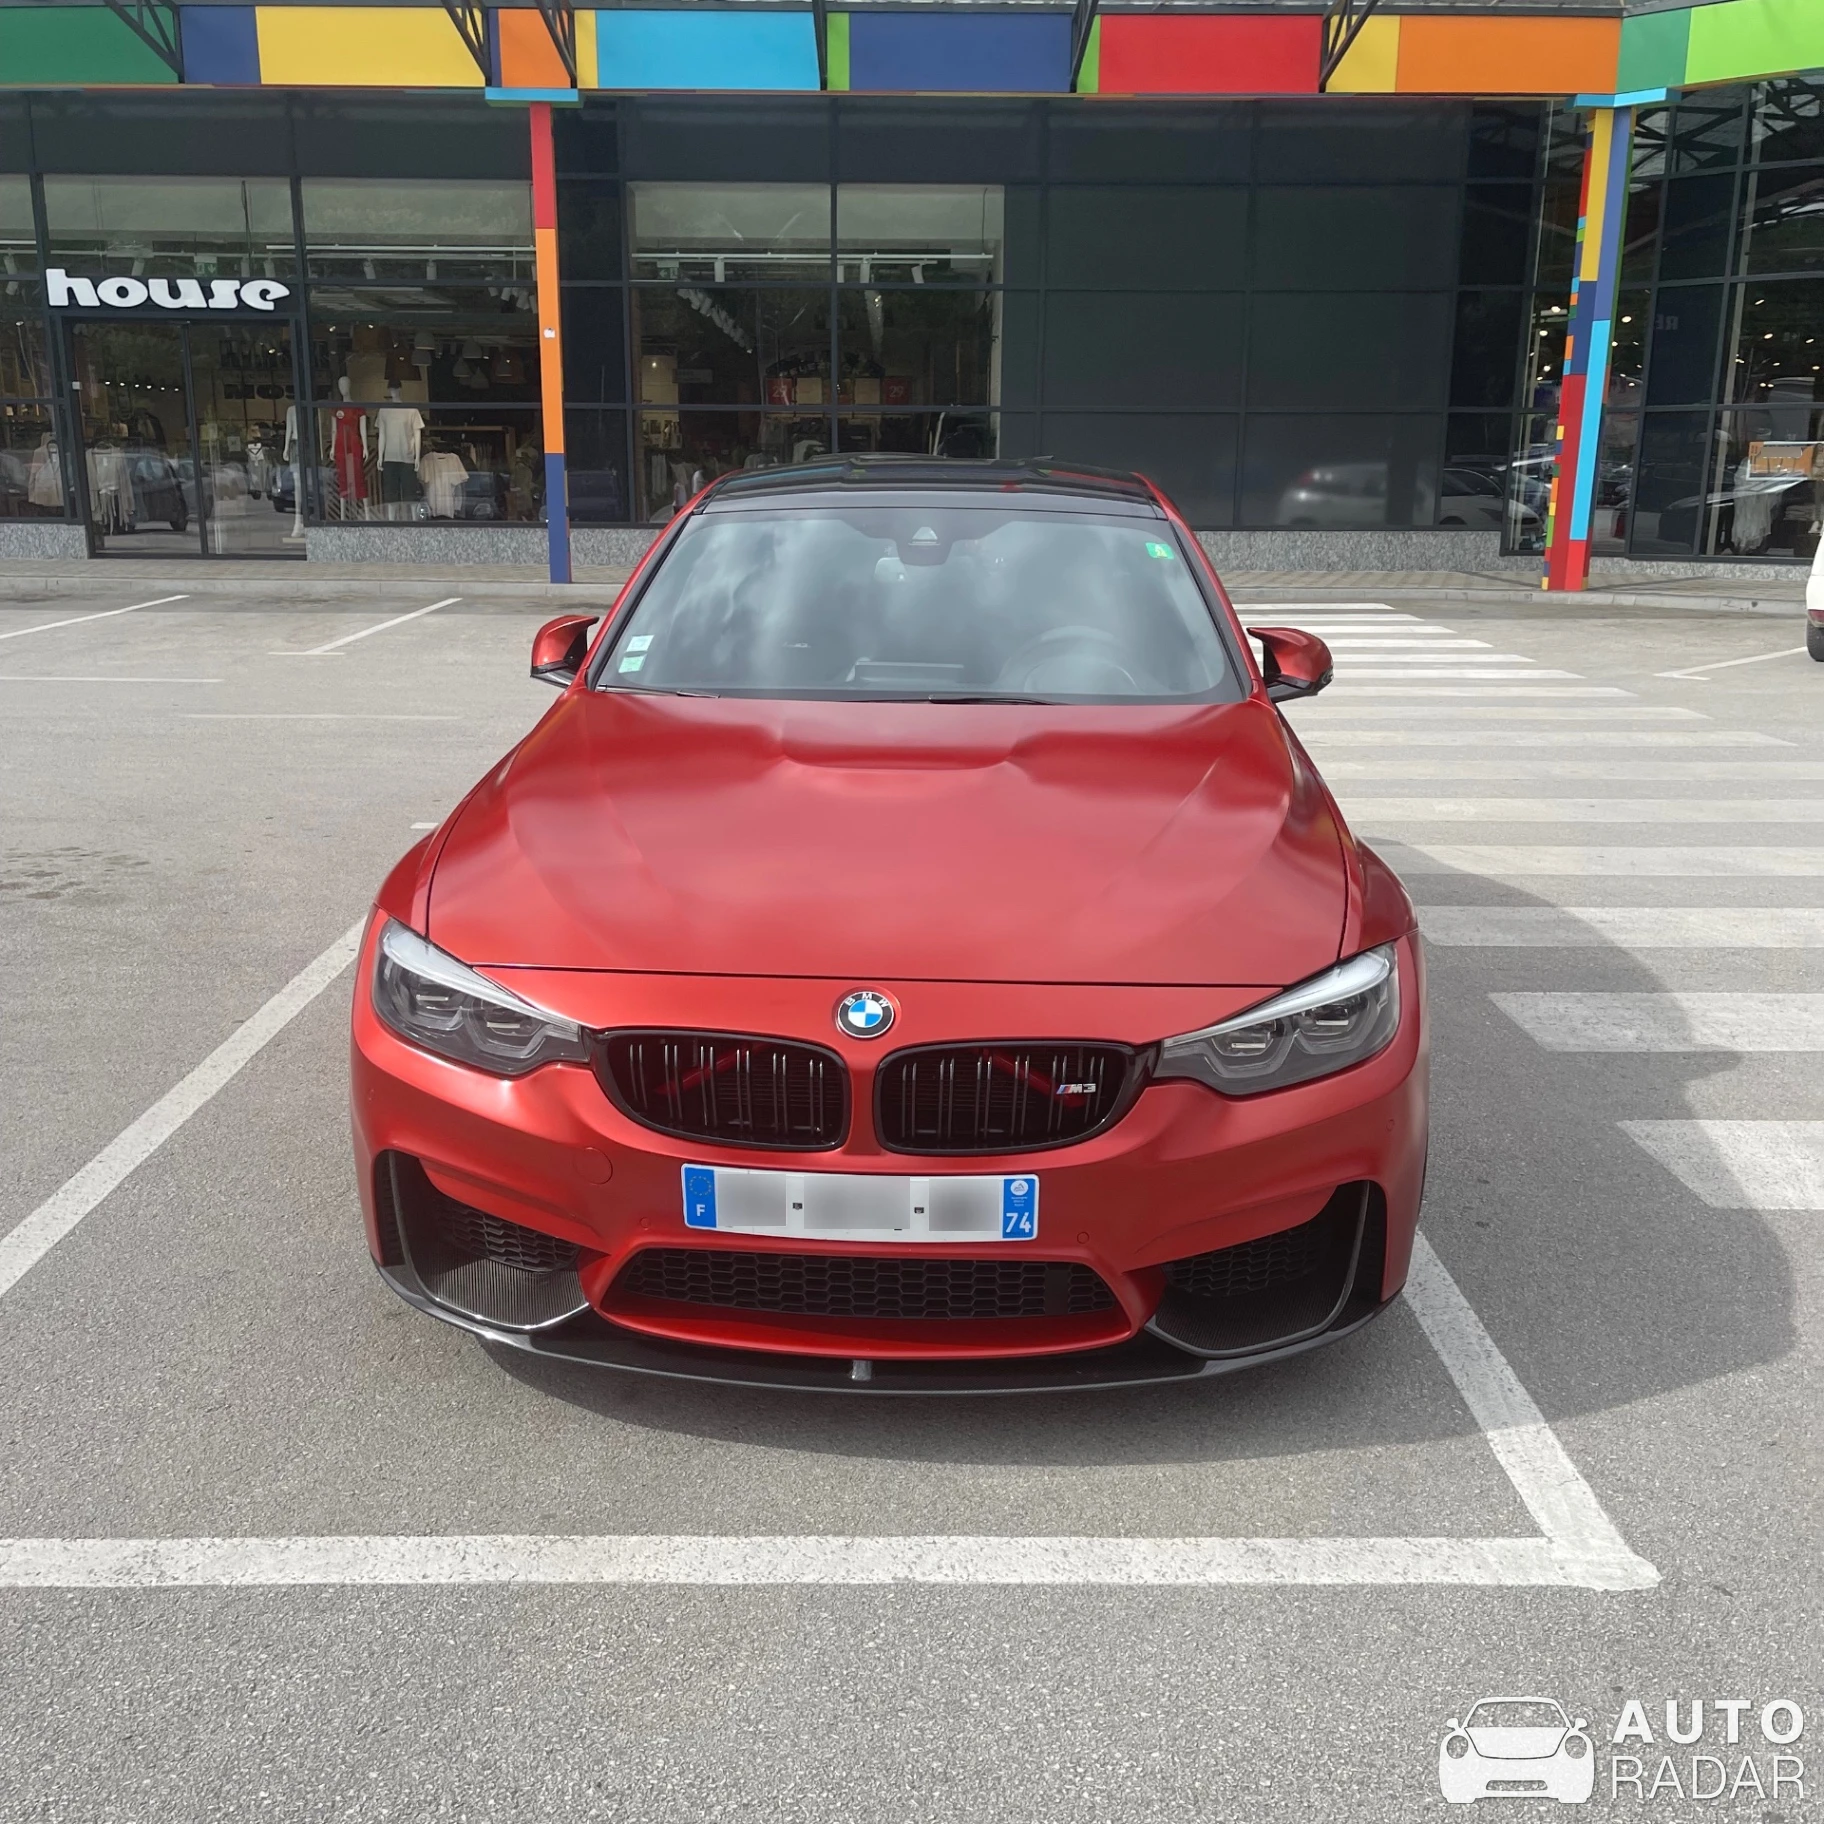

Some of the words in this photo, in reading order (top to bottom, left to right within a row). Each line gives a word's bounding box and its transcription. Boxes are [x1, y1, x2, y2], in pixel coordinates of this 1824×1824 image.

[45, 268, 290, 311] house
[844, 992, 890, 1008] BMW
[1066, 1083, 1097, 1095] M3
[695, 1203, 706, 1217] F
[1005, 1212, 1032, 1233] 74
